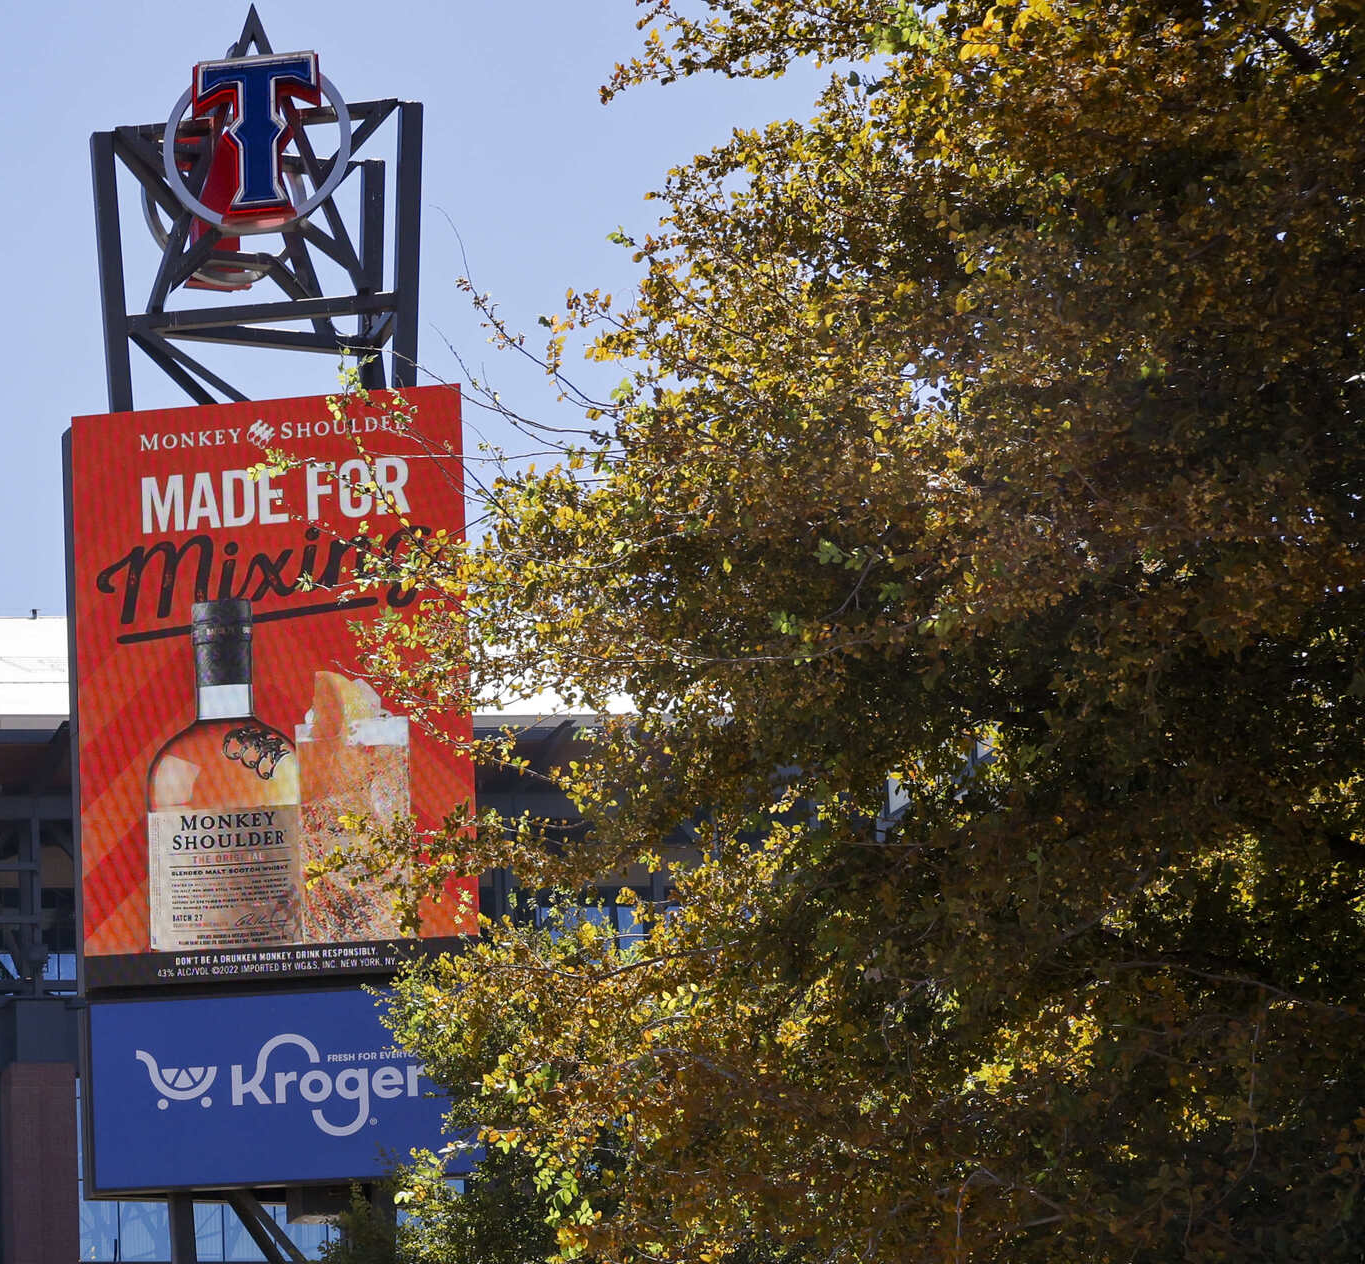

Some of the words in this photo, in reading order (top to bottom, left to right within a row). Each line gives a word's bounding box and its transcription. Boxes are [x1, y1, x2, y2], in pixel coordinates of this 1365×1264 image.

[140, 429, 239, 451] MONKEY
[141, 466, 289, 534] MADE
[306, 456, 410, 520] FOR
[181, 811, 275, 831] MONKEY
[172, 831, 284, 850] SHOULDER
[215, 851, 265, 863] ORIGIAL
[205, 868, 226, 876] MALT
[175, 956, 199, 966] DON'T
[200, 955, 211, 965] BE
[213, 955, 219, 964] A
[220, 953, 257, 963] DRUNKEN
[296, 949, 320, 959] DRINK
[241, 963, 279, 973] IMPORTED
[282, 962, 292, 972] BY
[340, 958, 358, 968] NEW
[327, 1053, 355, 1062] FRESH
[358, 1052, 377, 1061] FOR
[231, 1033, 425, 1136] Kroger
